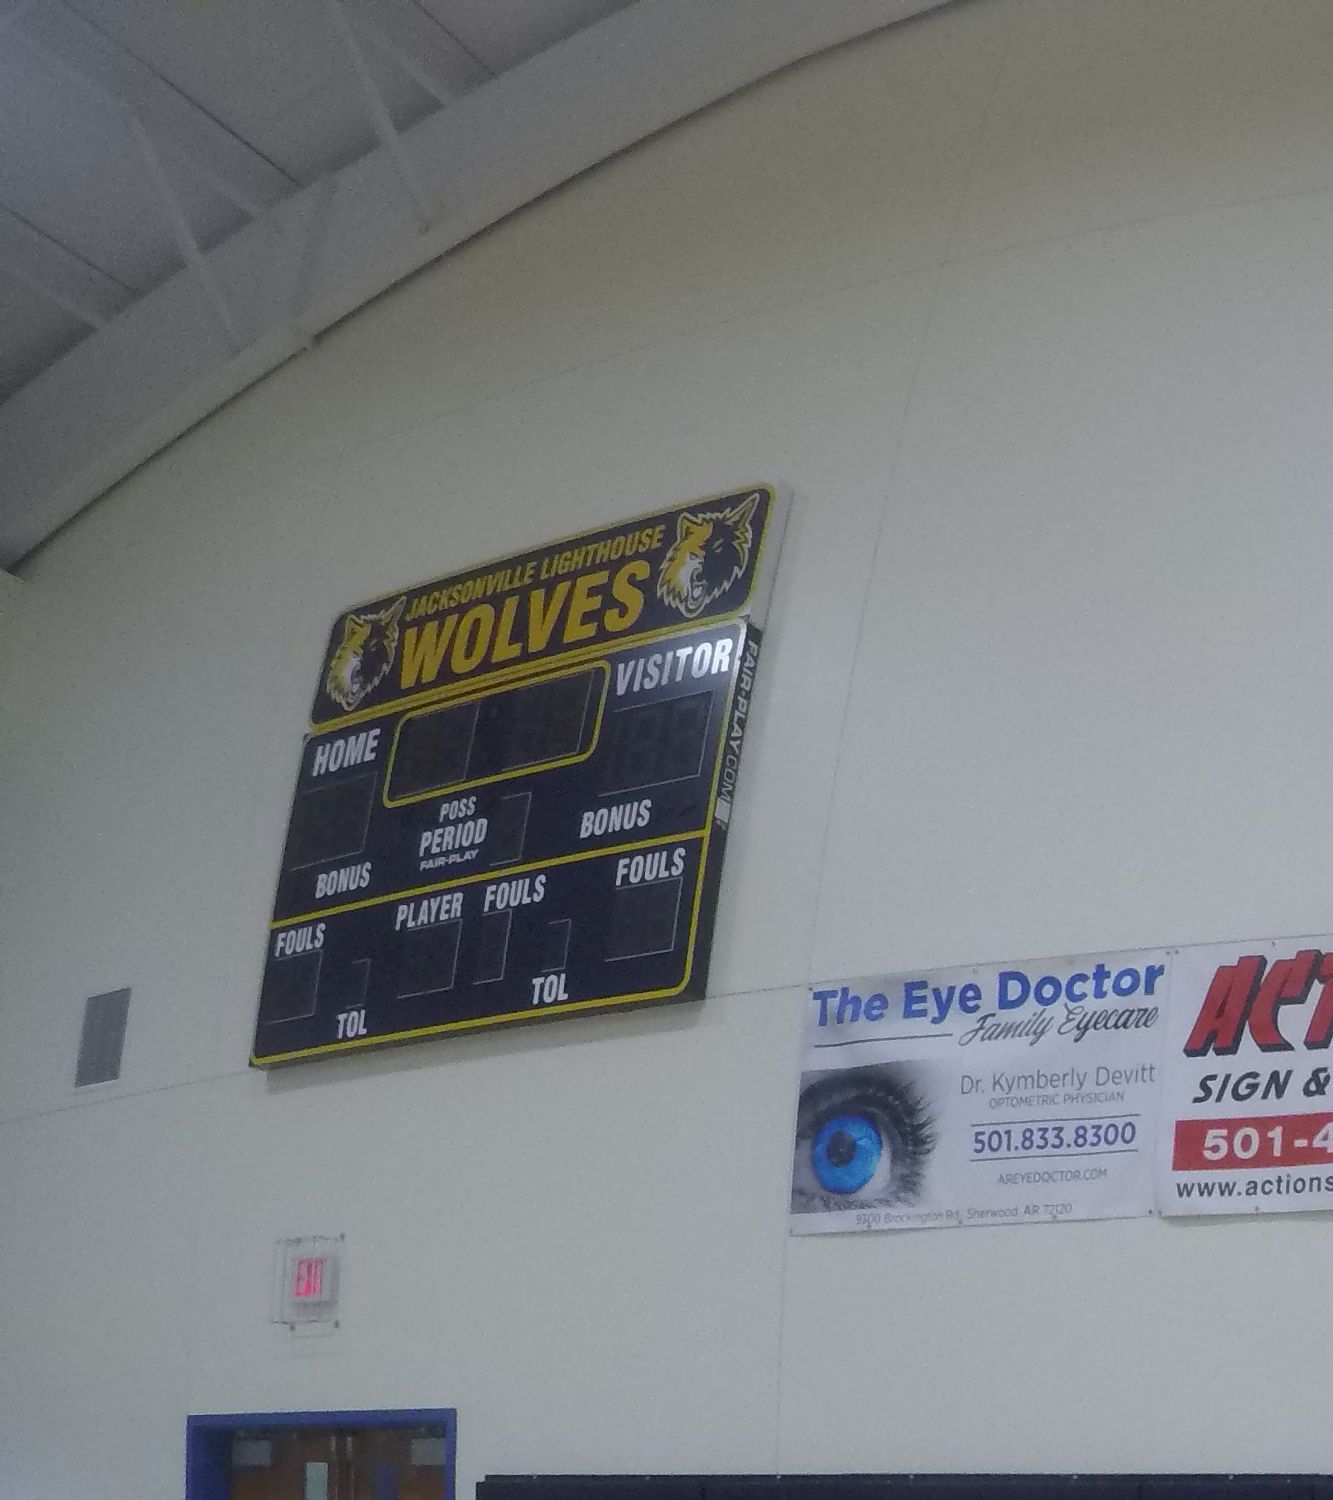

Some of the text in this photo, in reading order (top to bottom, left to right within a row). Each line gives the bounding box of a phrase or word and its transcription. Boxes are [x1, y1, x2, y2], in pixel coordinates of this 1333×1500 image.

[405, 525, 665, 621] JACKSONVILLE LIGHTHOUSE
[400, 560, 650, 690] WOLVES
[616, 638, 734, 696] VISITOR
[312, 729, 380, 776] HOME
[440, 796, 477, 822] POSS
[580, 799, 652, 838] BONUS
[419, 818, 488, 857] PERIOD
[420, 848, 479, 872] FAIR-PLAY
[615, 847, 686, 885] FOULS
[316, 863, 371, 898] BONUS
[396, 875, 546, 930] PLAYER FOULS
[274, 923, 326, 957] FOULS
[532, 973, 569, 1005] TOL
[813, 963, 1165, 1027] The Eye Doctor
[336, 1007, 368, 1039] TOL
[958, 1002, 1160, 1046] Family Eyecare
[960, 1063, 1156, 1095] Dr. Kymberly Devitt
[1193, 1069, 1293, 1104] SIGN
[1302, 1067, 1331, 1097] &
[989, 1091, 1126, 1109] OPTOMETRIC PHYSICIAN
[973, 1121, 1137, 1154] 501.833.8300
[998, 1168, 1108, 1185] AREYEDOCTOR.COM
